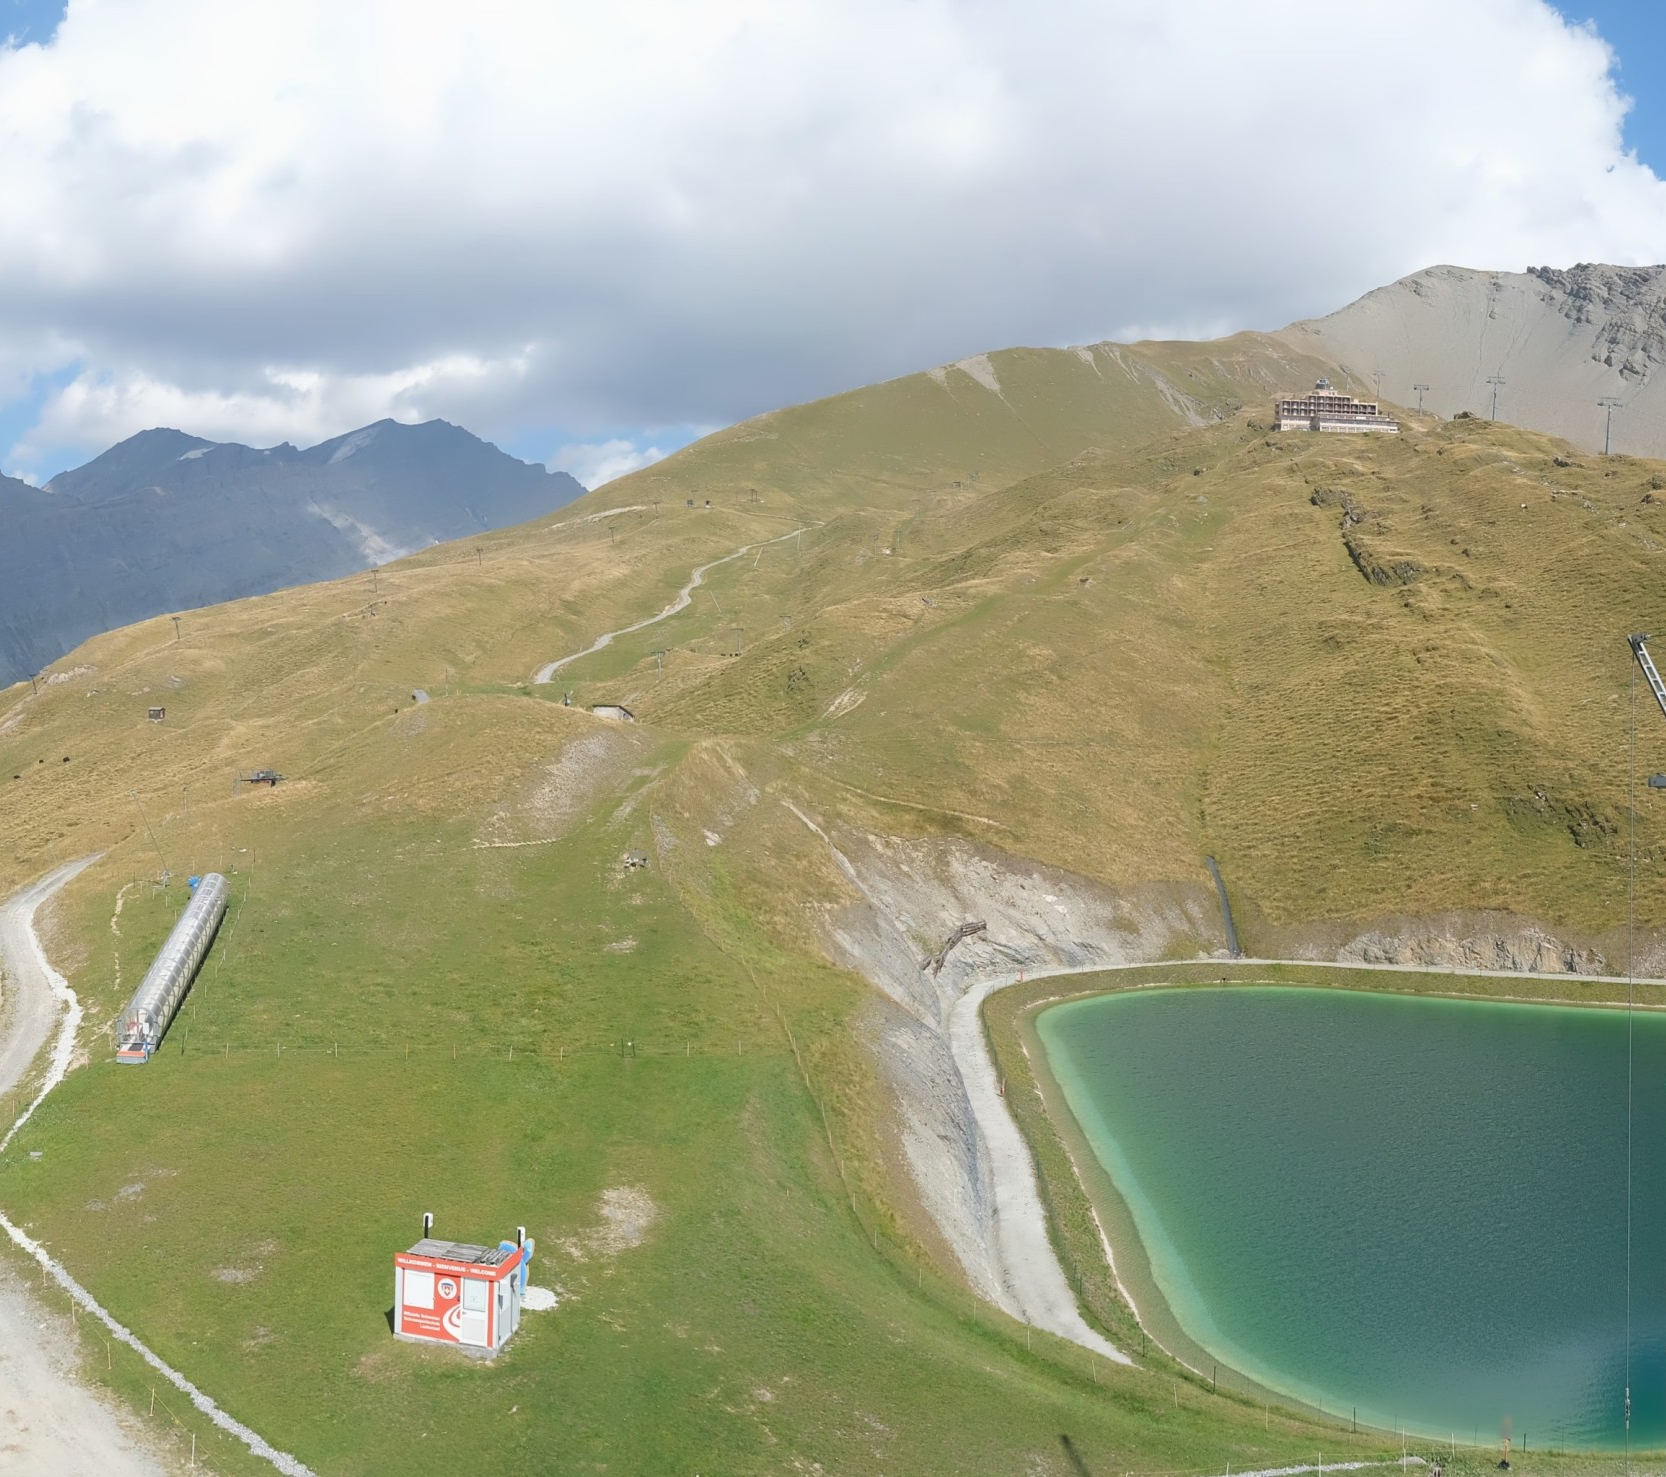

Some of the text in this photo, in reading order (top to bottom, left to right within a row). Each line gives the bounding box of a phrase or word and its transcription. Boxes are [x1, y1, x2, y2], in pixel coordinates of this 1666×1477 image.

[397, 1258, 432, 1267] WILLKOMMEN
[436, 1263, 466, 1272] BIENVENUE
[470, 1268, 496, 1276] WELCOME
